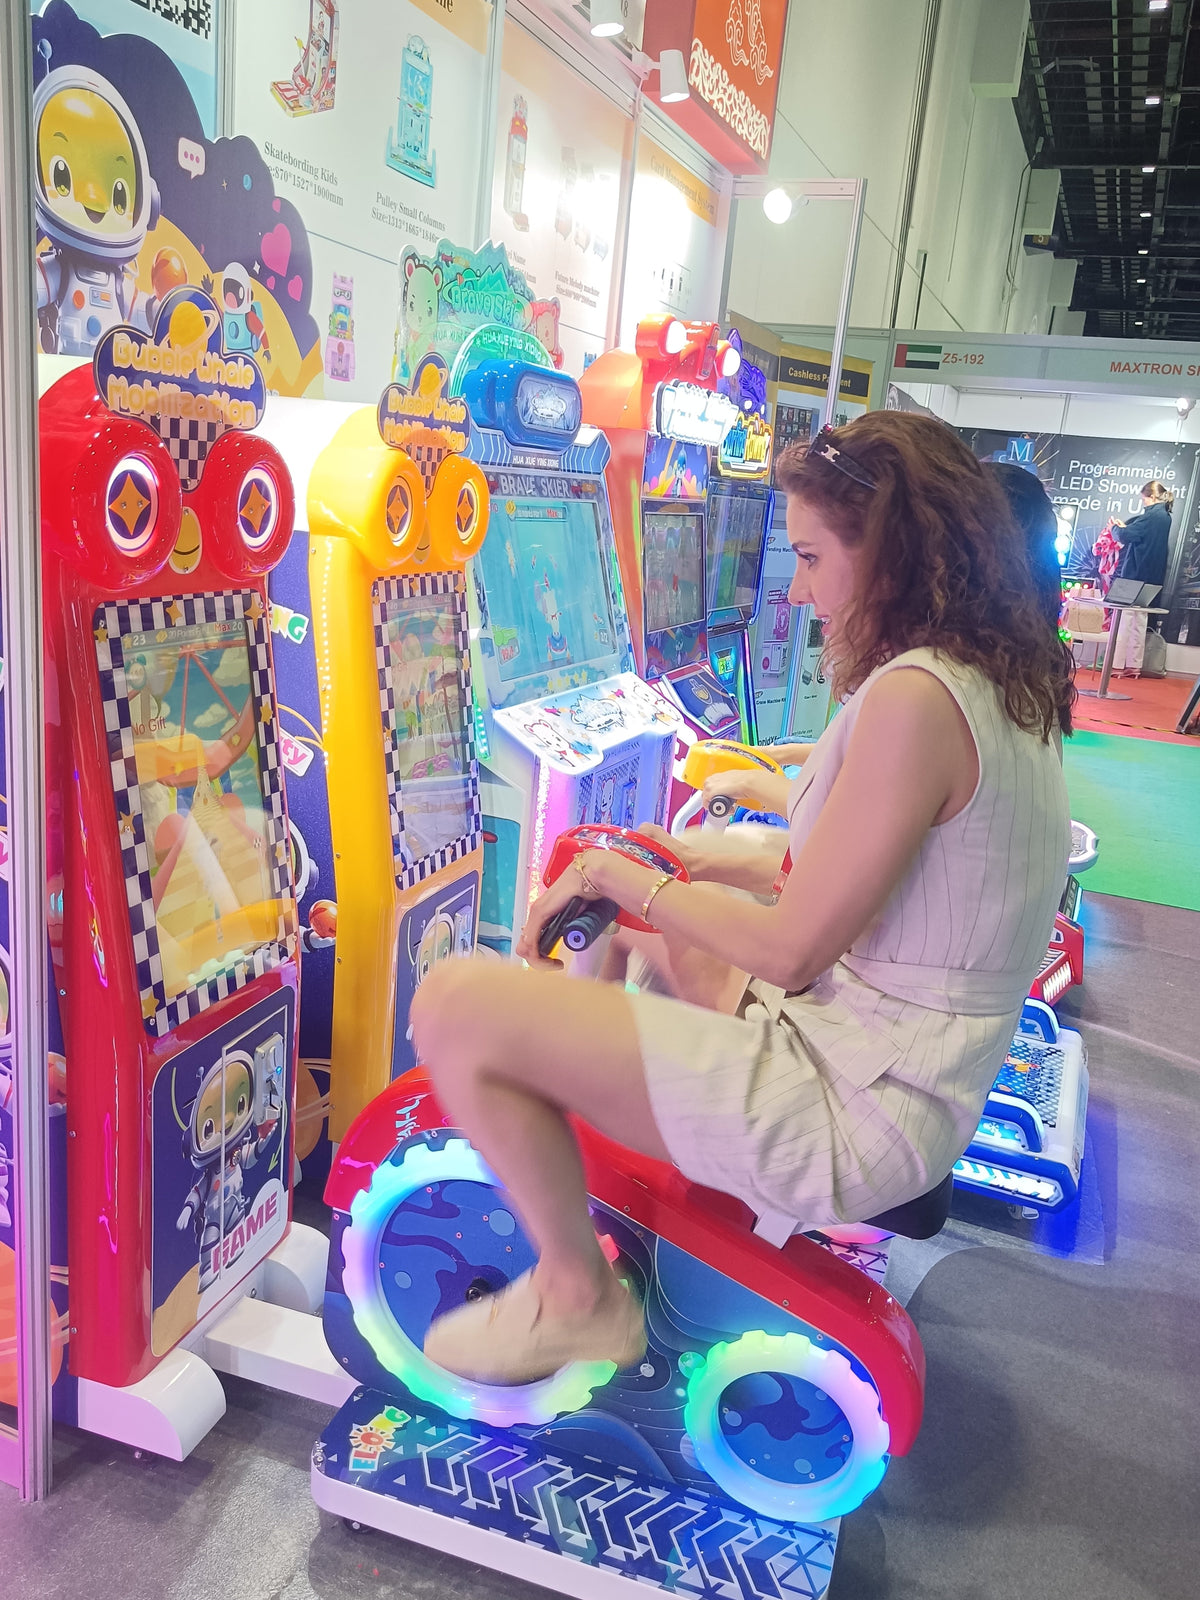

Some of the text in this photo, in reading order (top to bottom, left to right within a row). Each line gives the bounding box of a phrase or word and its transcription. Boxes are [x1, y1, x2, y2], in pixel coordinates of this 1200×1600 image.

[264, 141, 338, 186] Skatebording Kids
[376, 191, 446, 232] Pulley Small Columns
[942, 353, 985, 366] Z5-192
[788, 366, 821, 382] Cashless
[1110, 361, 1183, 376] MAXTRON
[1008, 440, 1033, 462] M
[513, 455, 524, 465] HUA
[524, 456, 536, 466] XUE
[1068, 459, 1176, 481] Programmable
[500, 473, 570, 497] BRAVE SKIER
[1059, 475, 1094, 491] LED
[1106, 496, 1123, 513] in
[214, 622, 231, 633] Max
[232, 621, 243, 631] 20
[132, 634, 146, 646] 23
[131, 716, 166, 736] No Gift
[212, 1190, 278, 1274] GAME
